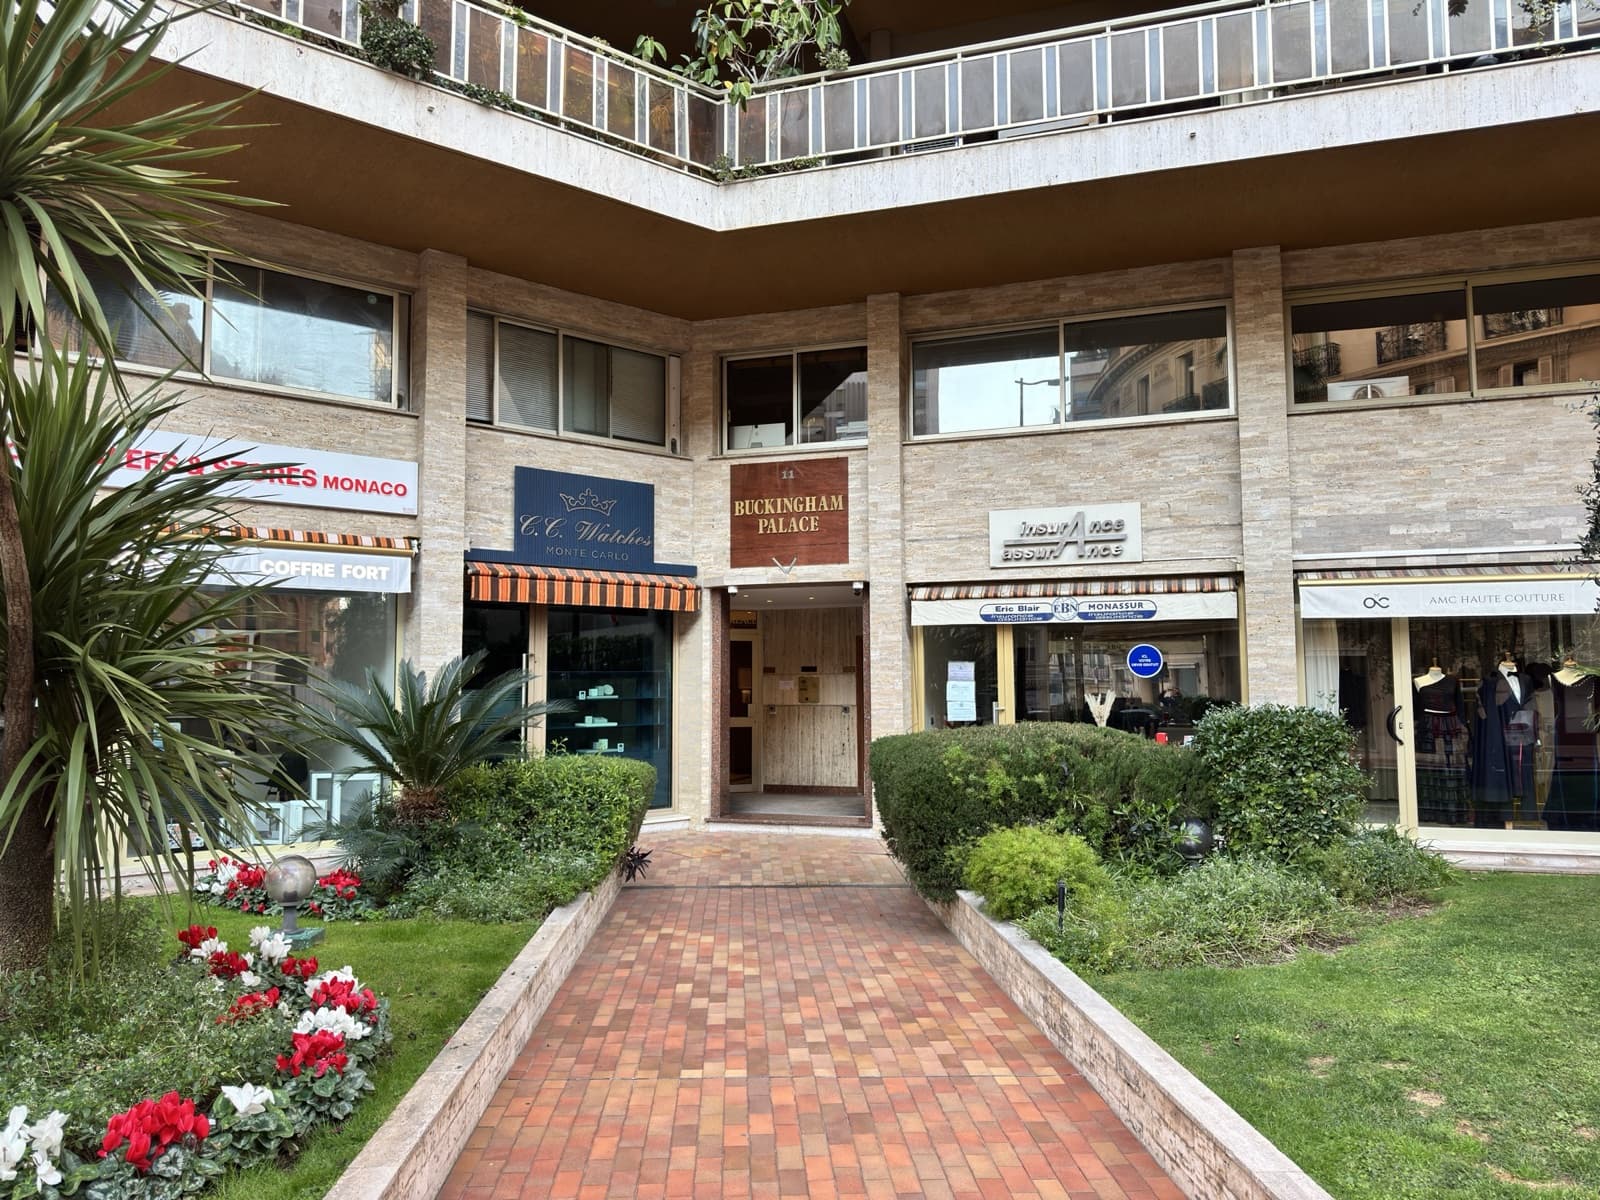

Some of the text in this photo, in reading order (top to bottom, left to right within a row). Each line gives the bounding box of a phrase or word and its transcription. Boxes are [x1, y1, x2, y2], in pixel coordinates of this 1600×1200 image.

[96, 447, 179, 473] EFS
[323, 475, 407, 497] MONACO
[781, 470, 795, 480] 11
[734, 494, 844, 516] BUCKINGHAM
[575, 520, 652, 547] Watches
[758, 516, 820, 535] PALACE
[546, 546, 629, 561] MONTE CARLO
[260, 559, 390, 581] COFFRE FORT
[1088, 602, 1144, 611] MONASSUR
[1429, 593, 1565, 605] AMC HAUTE COUTURE
